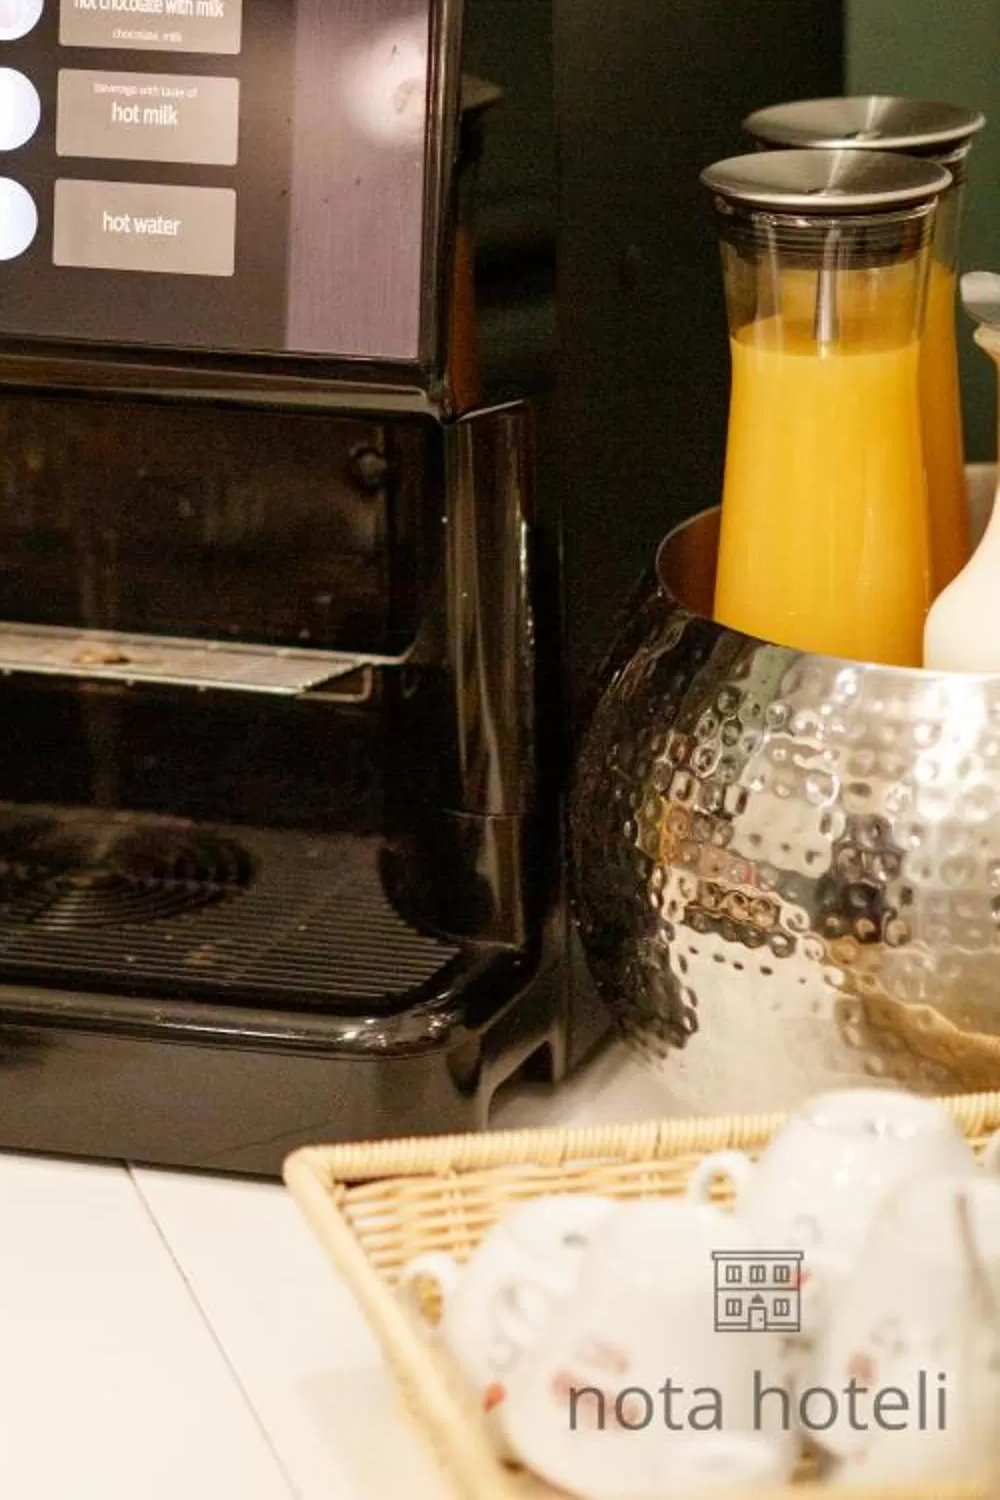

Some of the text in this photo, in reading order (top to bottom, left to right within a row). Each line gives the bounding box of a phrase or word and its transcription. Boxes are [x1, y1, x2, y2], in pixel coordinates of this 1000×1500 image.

[111, 100, 178, 125] hot milk
[102, 209, 181, 237] hot water
